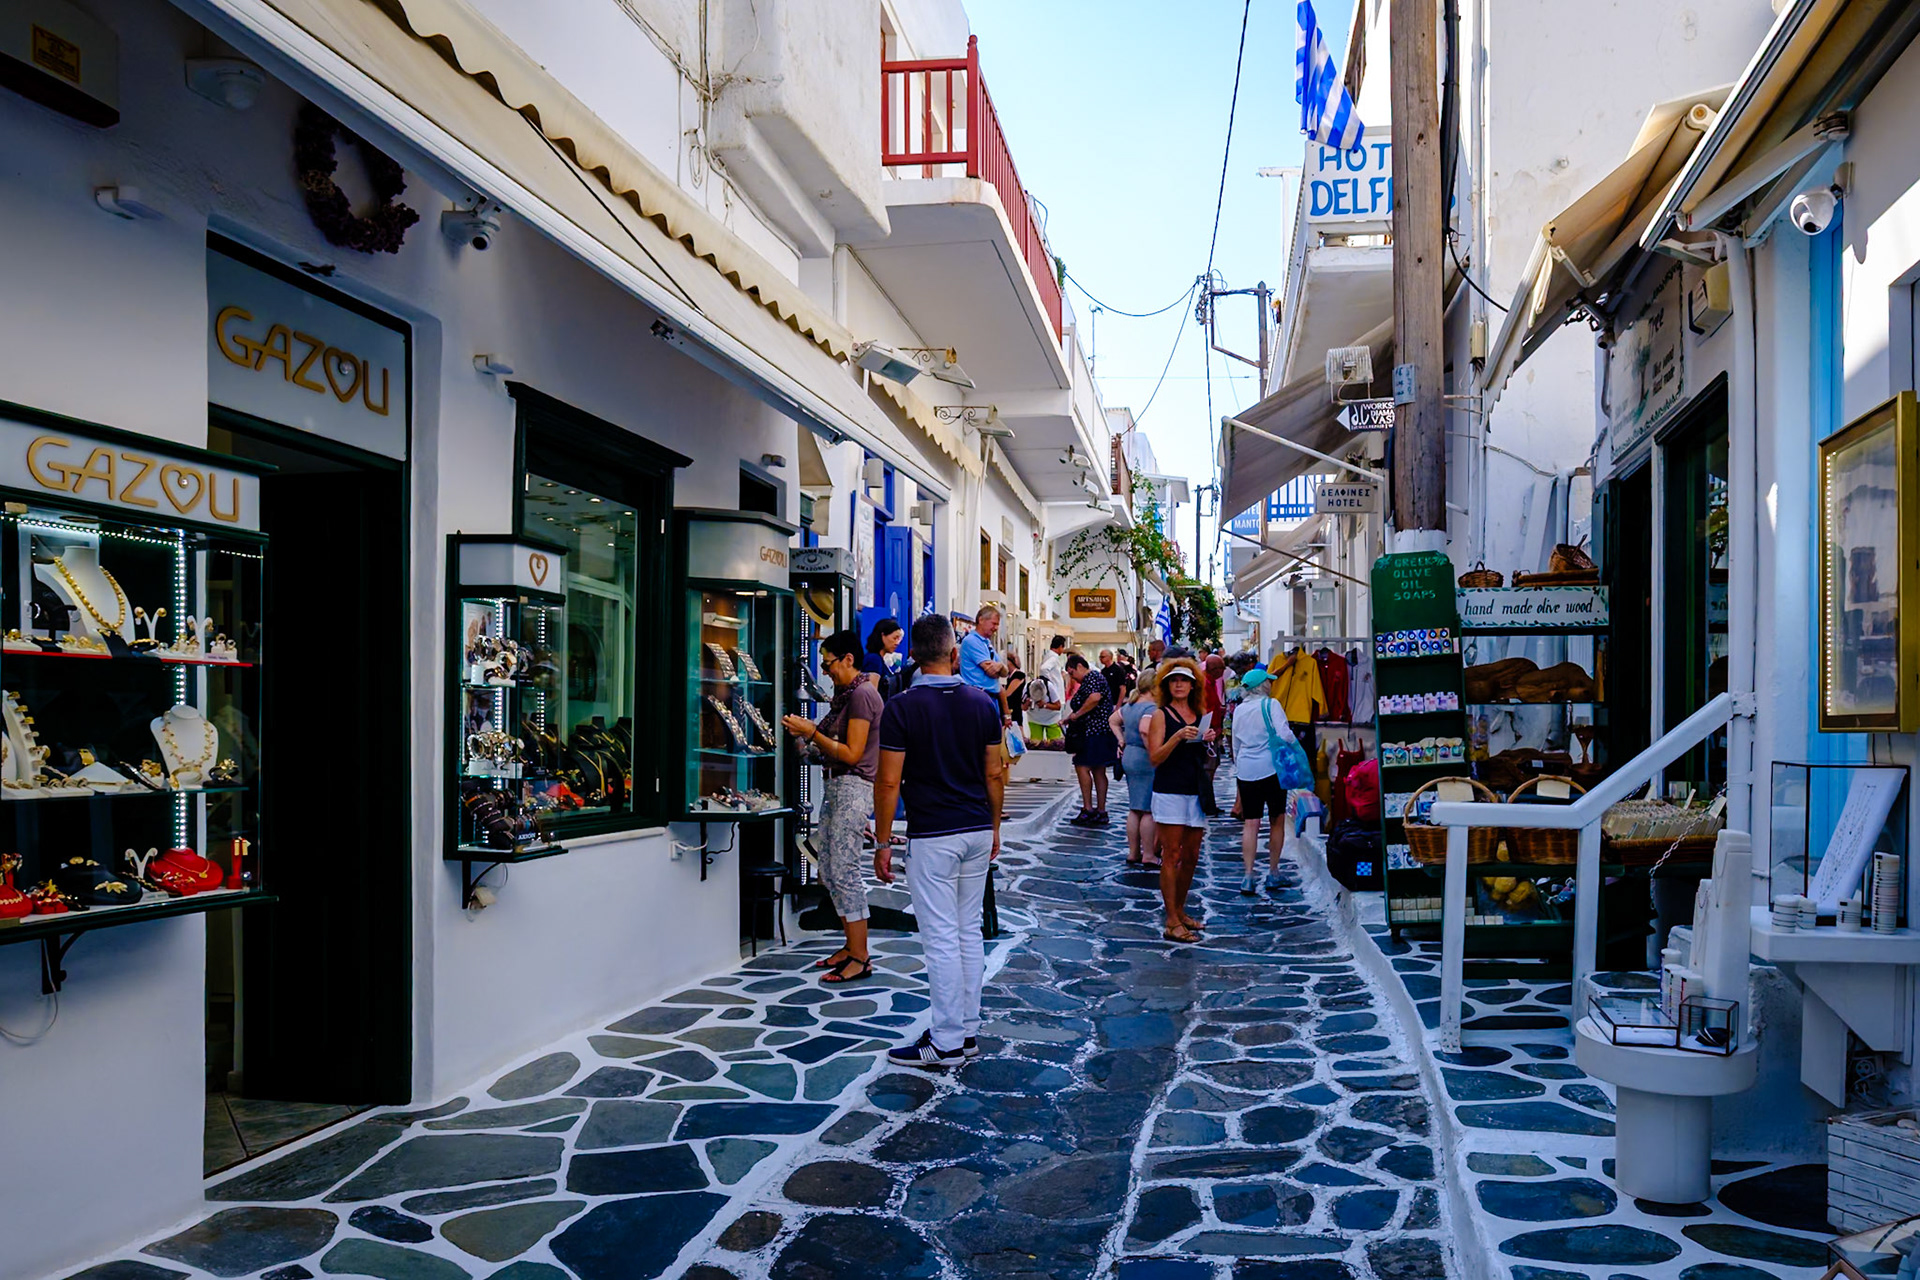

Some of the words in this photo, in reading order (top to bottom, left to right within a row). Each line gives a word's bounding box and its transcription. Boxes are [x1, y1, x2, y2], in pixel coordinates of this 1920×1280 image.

[1319, 143, 1392, 172] HOT
[215, 305, 389, 416] GAZOU
[1362, 402, 1394, 410] WORKS
[27, 436, 240, 523] GAZOU
[1321, 488, 1371, 497] ΔΕΛΦΙΝΕΣ
[1327, 499, 1363, 507] HOTEL
[760, 546, 788, 568] GAZOU
[791, 548, 817, 560] PANAMA
[1394, 556, 1432, 568] GREEK
[1393, 567, 1432, 579] OLIVE
[1401, 580, 1423, 590] OIL
[1393, 589, 1436, 601] SOAPS
[1465, 599, 1495, 615] hand
[1502, 598, 1533, 614] made
[1536, 597, 1560, 613] olive
